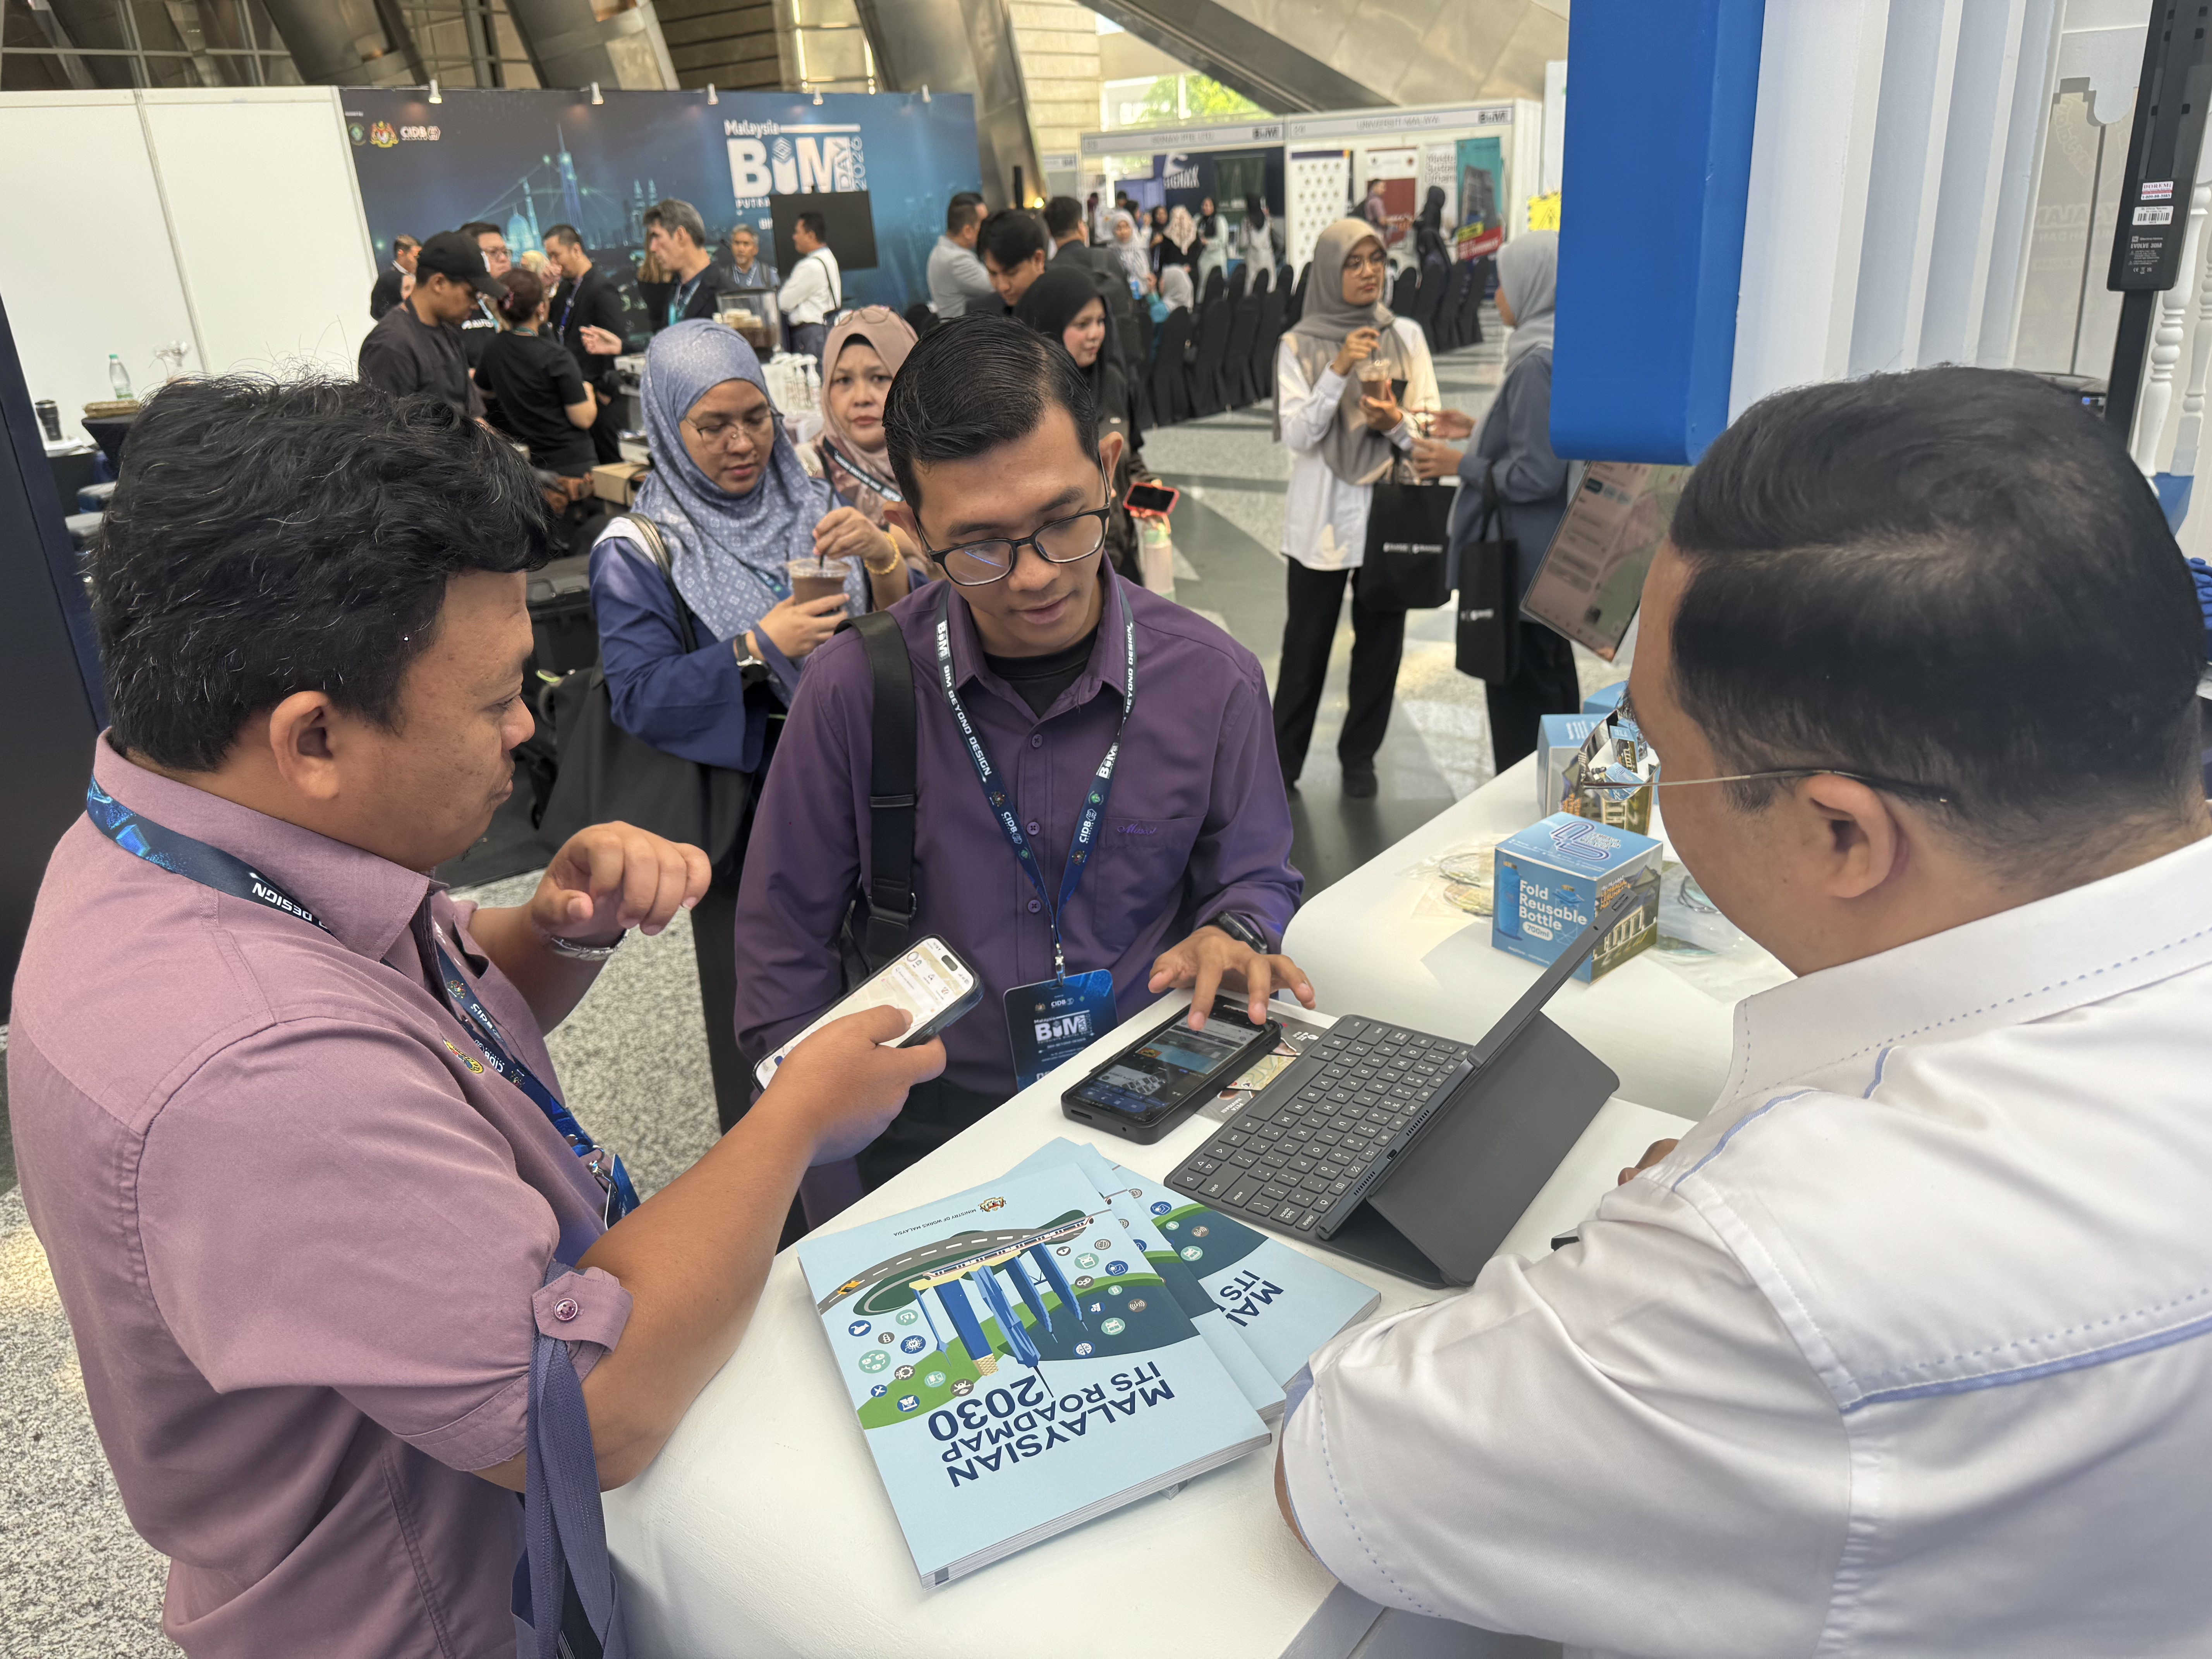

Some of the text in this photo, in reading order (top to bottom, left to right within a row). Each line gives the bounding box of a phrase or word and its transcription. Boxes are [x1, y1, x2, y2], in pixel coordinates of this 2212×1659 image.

[400, 126, 427, 138] CIDB
[723, 119, 780, 139] Malaysia
[833, 140, 851, 190] DAY
[948, 690, 972, 734] BEYOND
[969, 737, 992, 775] DESIGN
[1003, 812, 1018, 833] CIDB
[1079, 821, 1091, 843] CIDB
[1520, 879, 1548, 900] Fold
[252, 883, 313, 922] DESIGN
[1519, 893, 1587, 925] Reusable
[1519, 907, 1562, 930] Bottle
[1527, 924, 1550, 938] 700ml
[1231, 1103, 1244, 1111] PETA
[1209, 1184, 1218, 1192] shift
[1233, 1191, 1243, 1200] enter
[952, 1209, 976, 1219] MINISTRY
[1279, 1207, 1290, 1217] space
[1285, 1211, 1295, 1219] back
[1303, 1215, 1314, 1226] delete
[893, 1226, 921, 1236] MALAYSIA
[922, 1219, 942, 1228] WORKS
[1220, 1269, 1261, 1300] ITS
[928, 1375, 1044, 1441] 2030
[942, 1361, 1162, 1463] ITS ROADMAP
[946, 1379, 1175, 1487] MALAYSIAN
